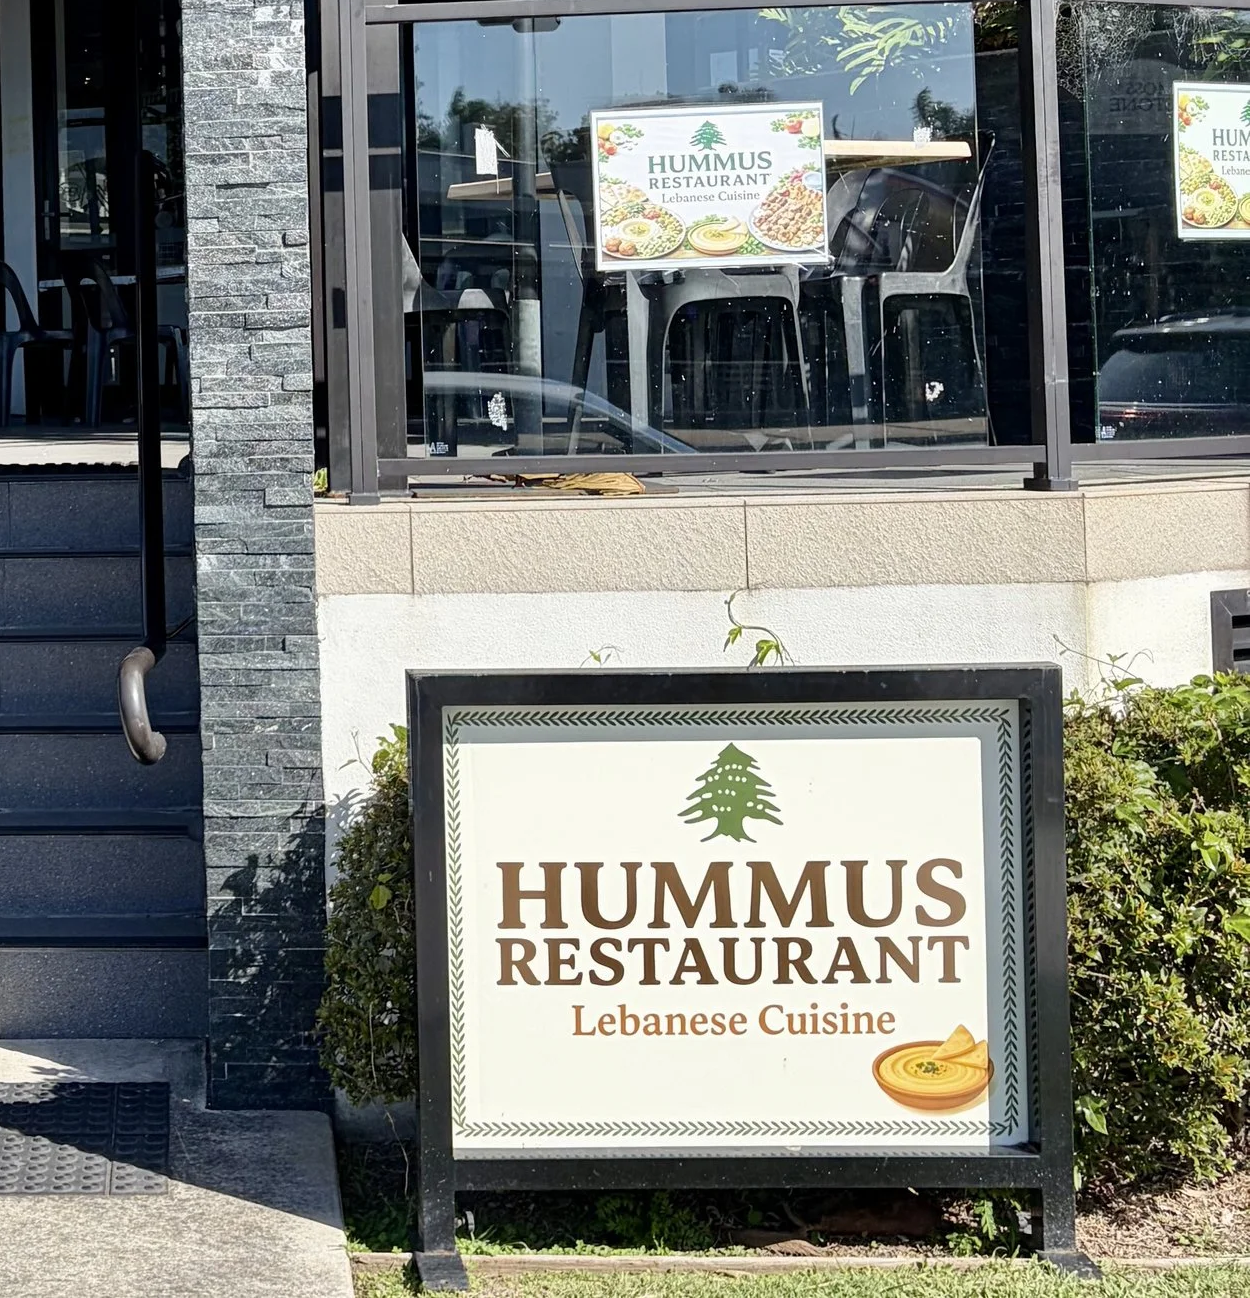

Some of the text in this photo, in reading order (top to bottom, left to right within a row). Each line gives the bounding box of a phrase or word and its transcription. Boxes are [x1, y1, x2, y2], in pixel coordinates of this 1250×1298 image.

[648, 150, 772, 174] HUMMUS
[649, 173, 771, 190] RESTAURANT
[662, 189, 761, 204] Lebanese Cuisine
[495, 858, 966, 930] HUMMUS
[495, 935, 970, 986] RESTAURANT
[571, 1003, 896, 1037] Lebanese Cuisine
